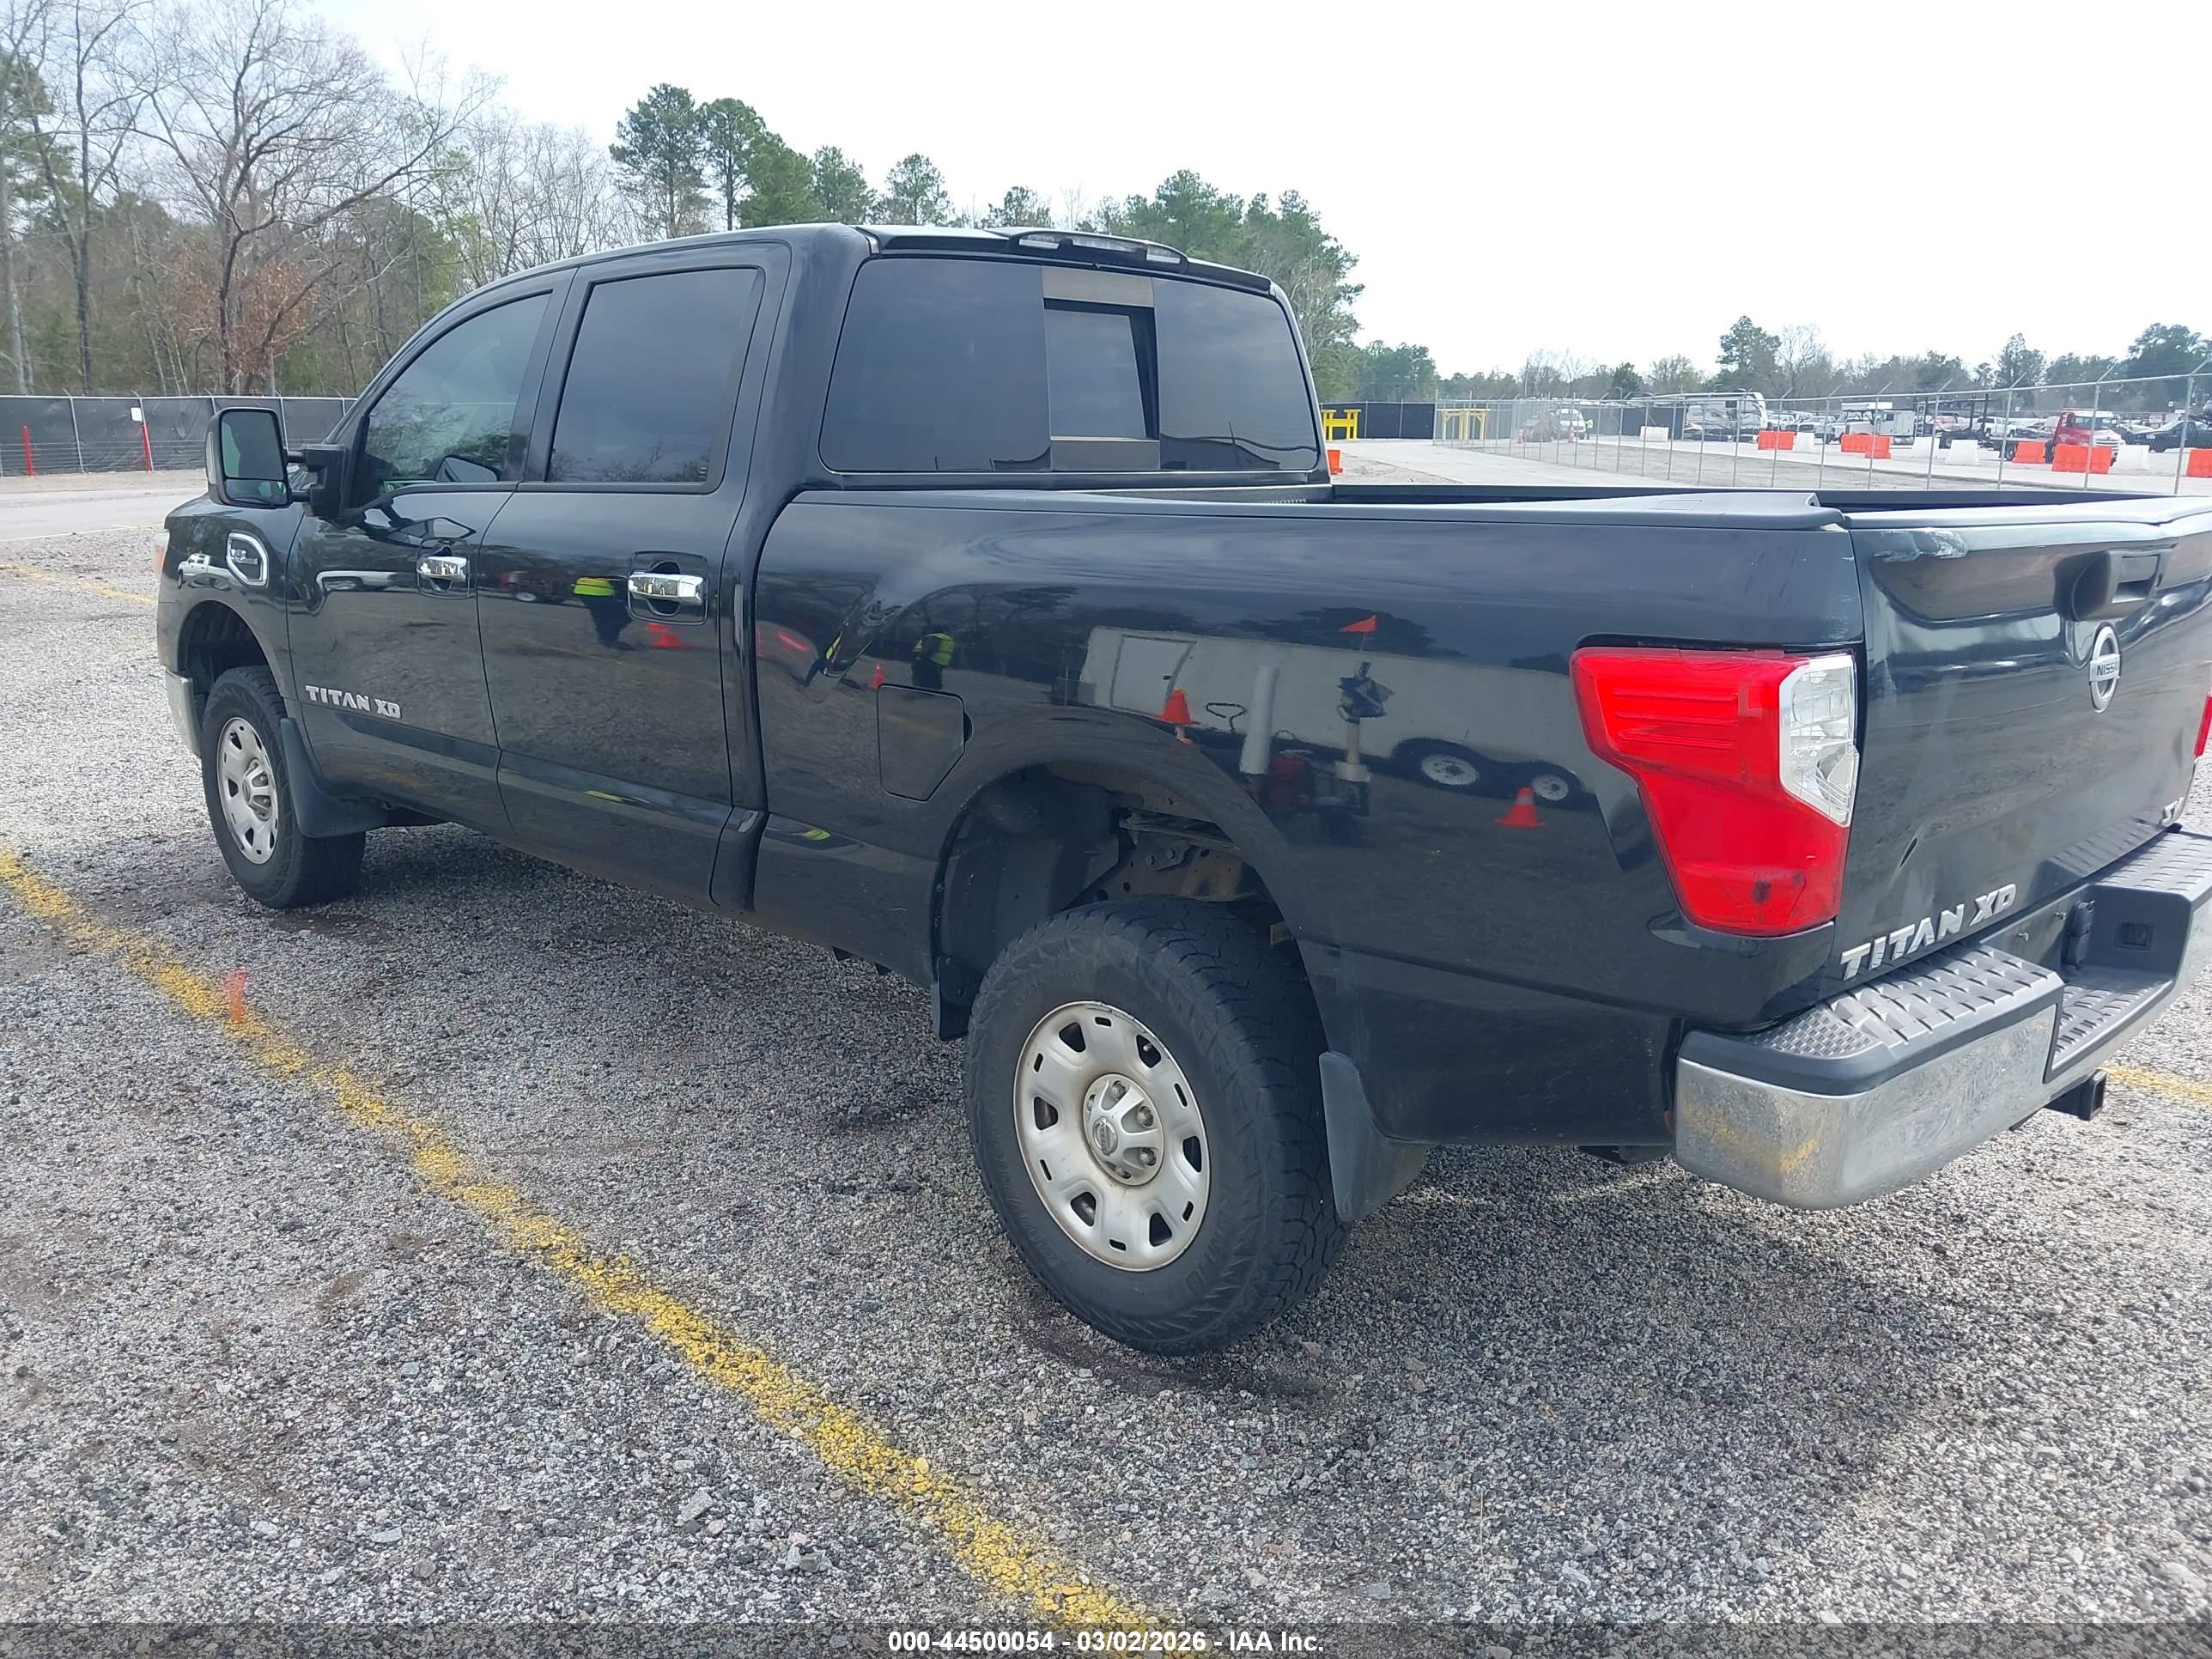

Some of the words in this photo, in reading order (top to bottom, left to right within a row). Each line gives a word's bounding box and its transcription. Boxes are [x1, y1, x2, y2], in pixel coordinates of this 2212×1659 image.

[305, 684, 370, 712] TITAN
[374, 698, 401, 719] XD
[1841, 903, 1965, 981] TITAN
[1969, 884, 2016, 927] XD
